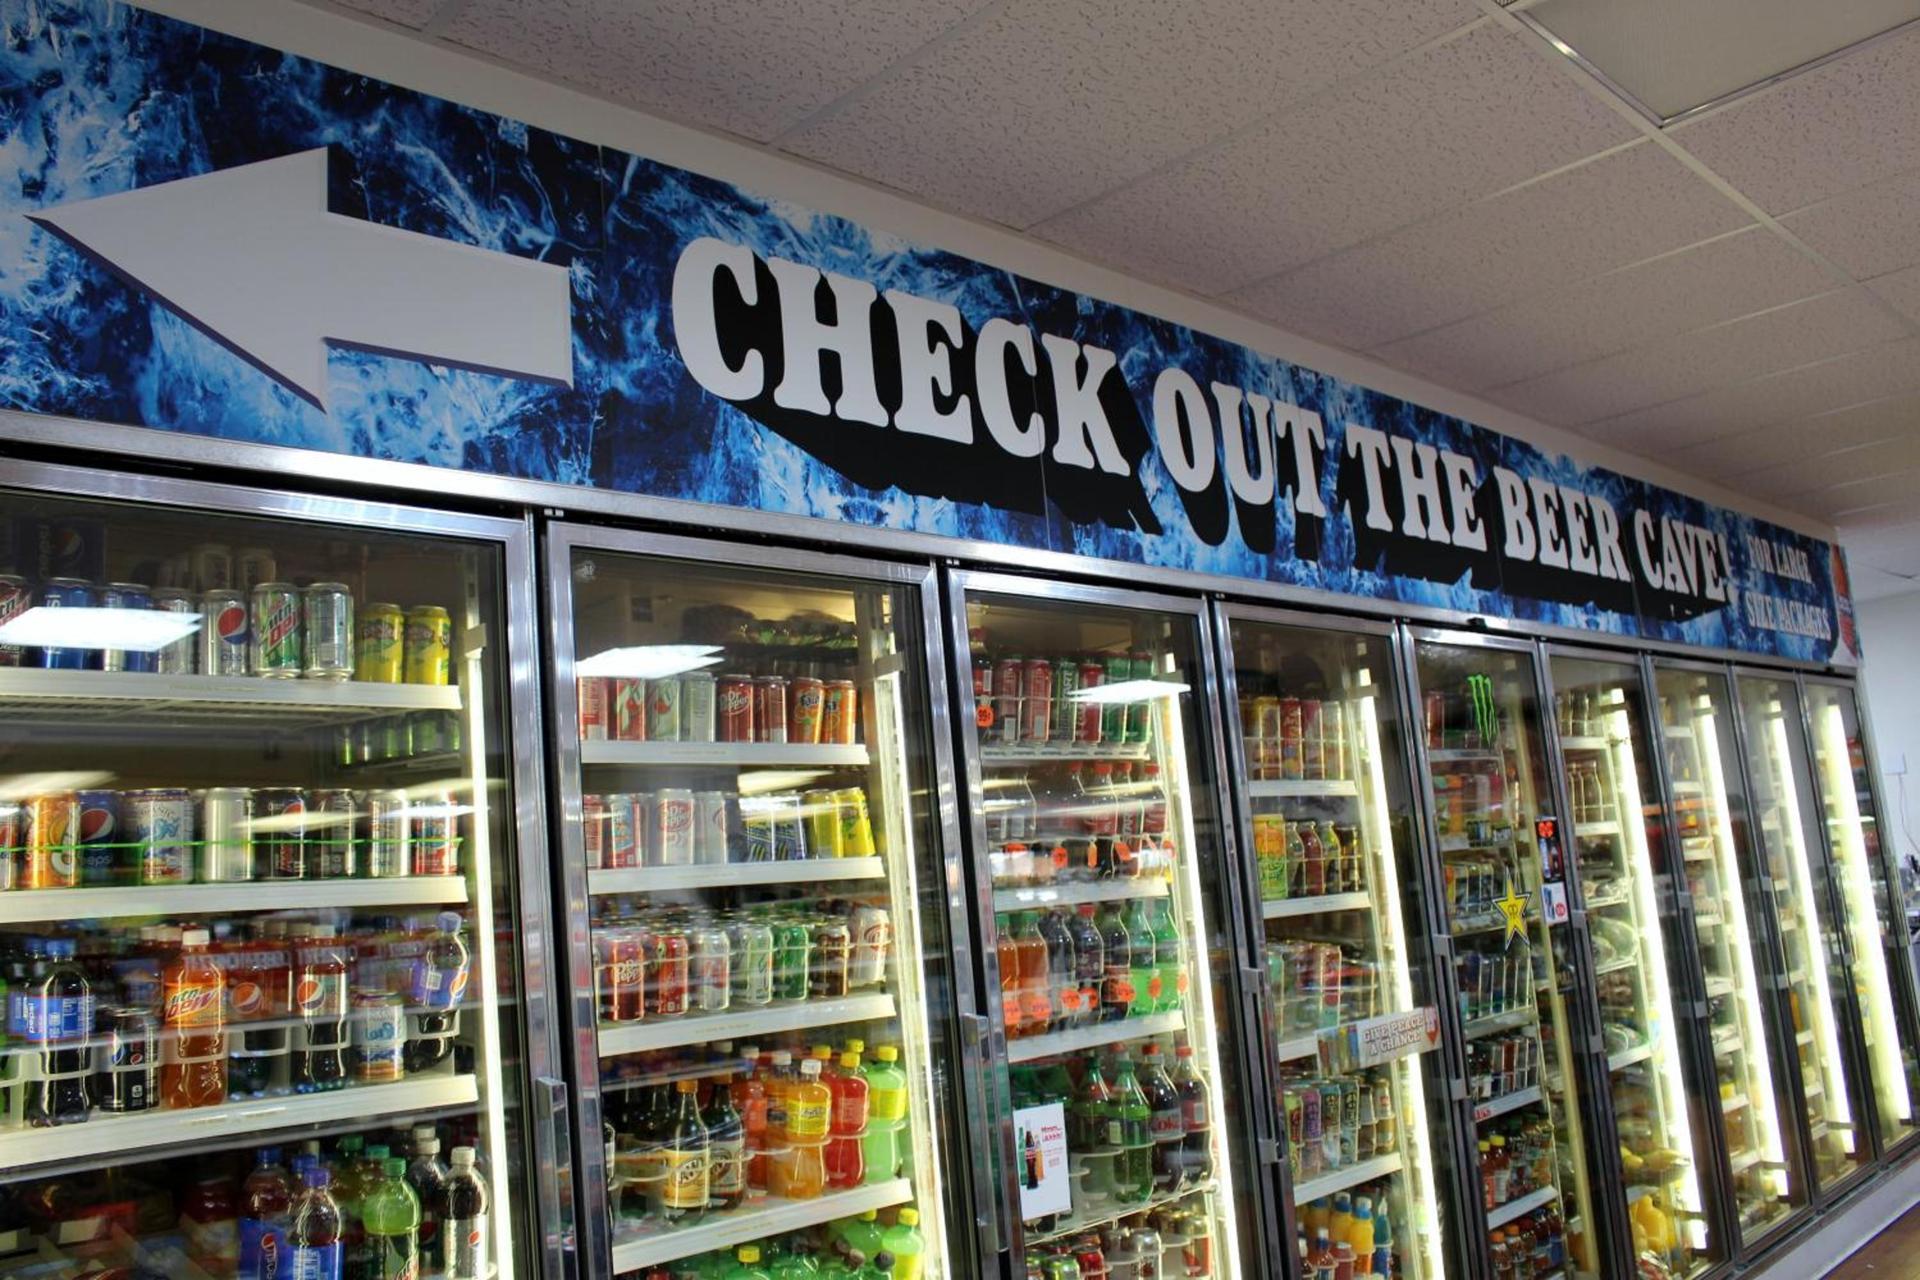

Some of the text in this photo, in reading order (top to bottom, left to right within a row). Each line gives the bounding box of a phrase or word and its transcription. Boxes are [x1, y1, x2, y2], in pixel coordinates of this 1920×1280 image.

[673, 236, 1731, 603] CHECK OUT THE BEER CAVE!
[1747, 537, 1813, 584] FOR LARGE
[1745, 591, 1776, 630] SIZE
[1776, 598, 1832, 641] PACKAGES
[1363, 1025, 1389, 1042] GIVE
[1389, 1014, 1424, 1035] PEACE
[1369, 1031, 1422, 1056] A CHANCE
